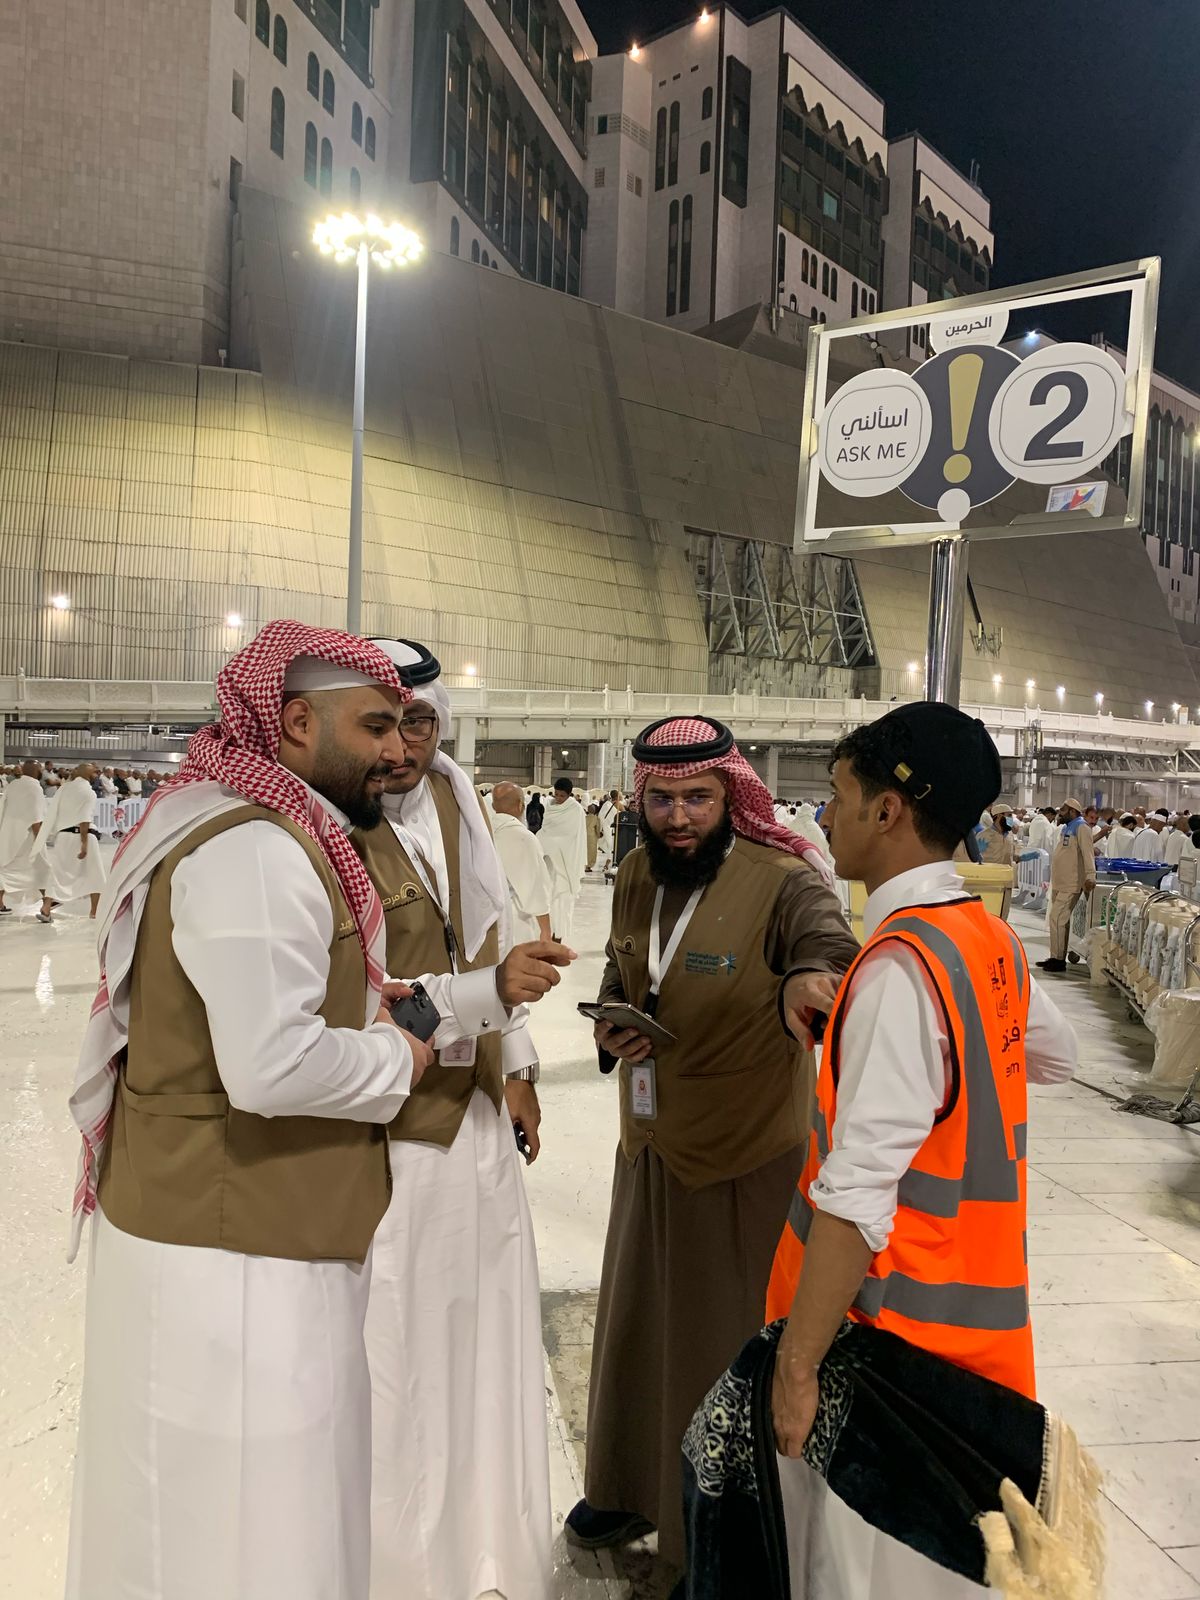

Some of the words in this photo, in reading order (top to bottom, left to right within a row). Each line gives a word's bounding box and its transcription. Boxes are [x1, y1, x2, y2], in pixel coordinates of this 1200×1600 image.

[945, 316, 992, 337] الحرمين
[841, 405, 908, 440] اسألني
[1023, 370, 1089, 462] 2
[836, 445, 871, 463] ASK
[877, 441, 907, 459] ME
